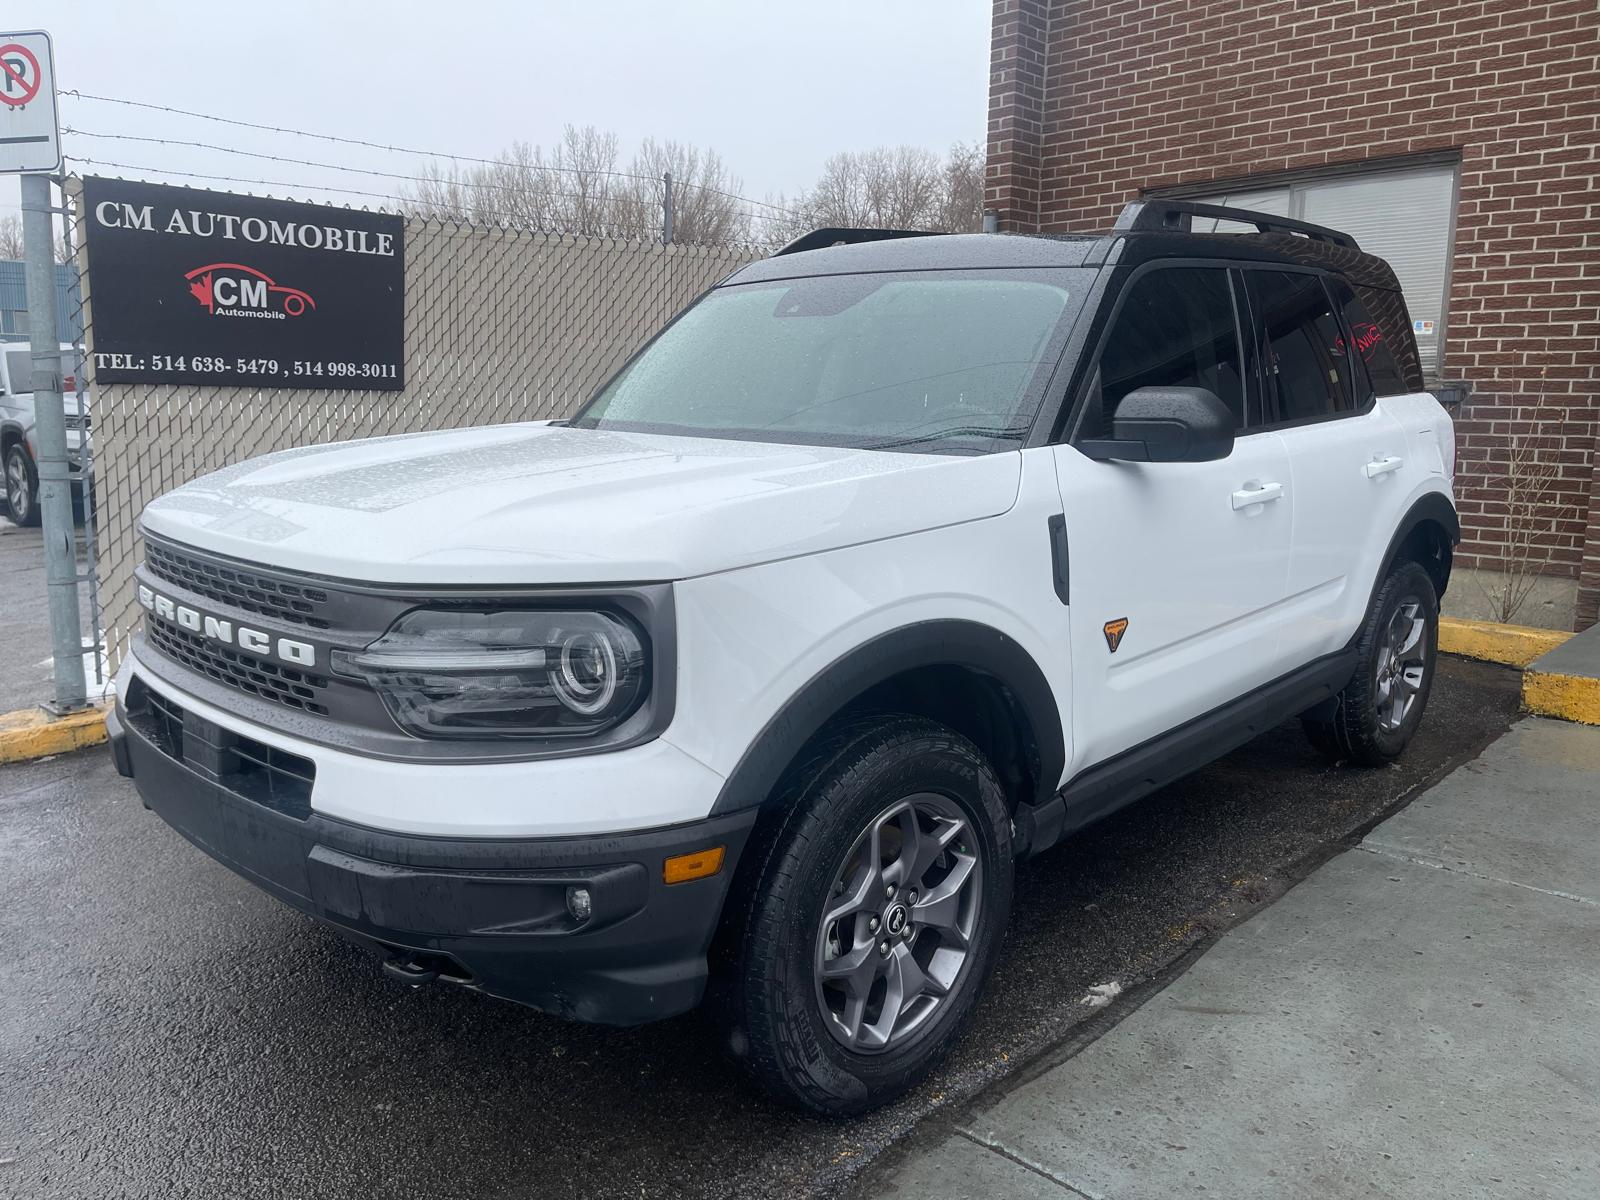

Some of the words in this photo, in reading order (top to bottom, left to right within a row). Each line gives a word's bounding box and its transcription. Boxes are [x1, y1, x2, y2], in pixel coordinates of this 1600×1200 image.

[95, 201, 155, 231] CM
[165, 208, 395, 257] AUTOMOBILE
[213, 277, 267, 308] CM
[215, 307, 286, 320] Automobile
[94, 353, 145, 370] TEL:
[151, 355, 186, 371] 514
[236, 358, 279, 375] 5479
[293, 361, 324, 376] 514
[327, 362, 397, 378] 998-3011
[139, 584, 315, 667] BRONCO
